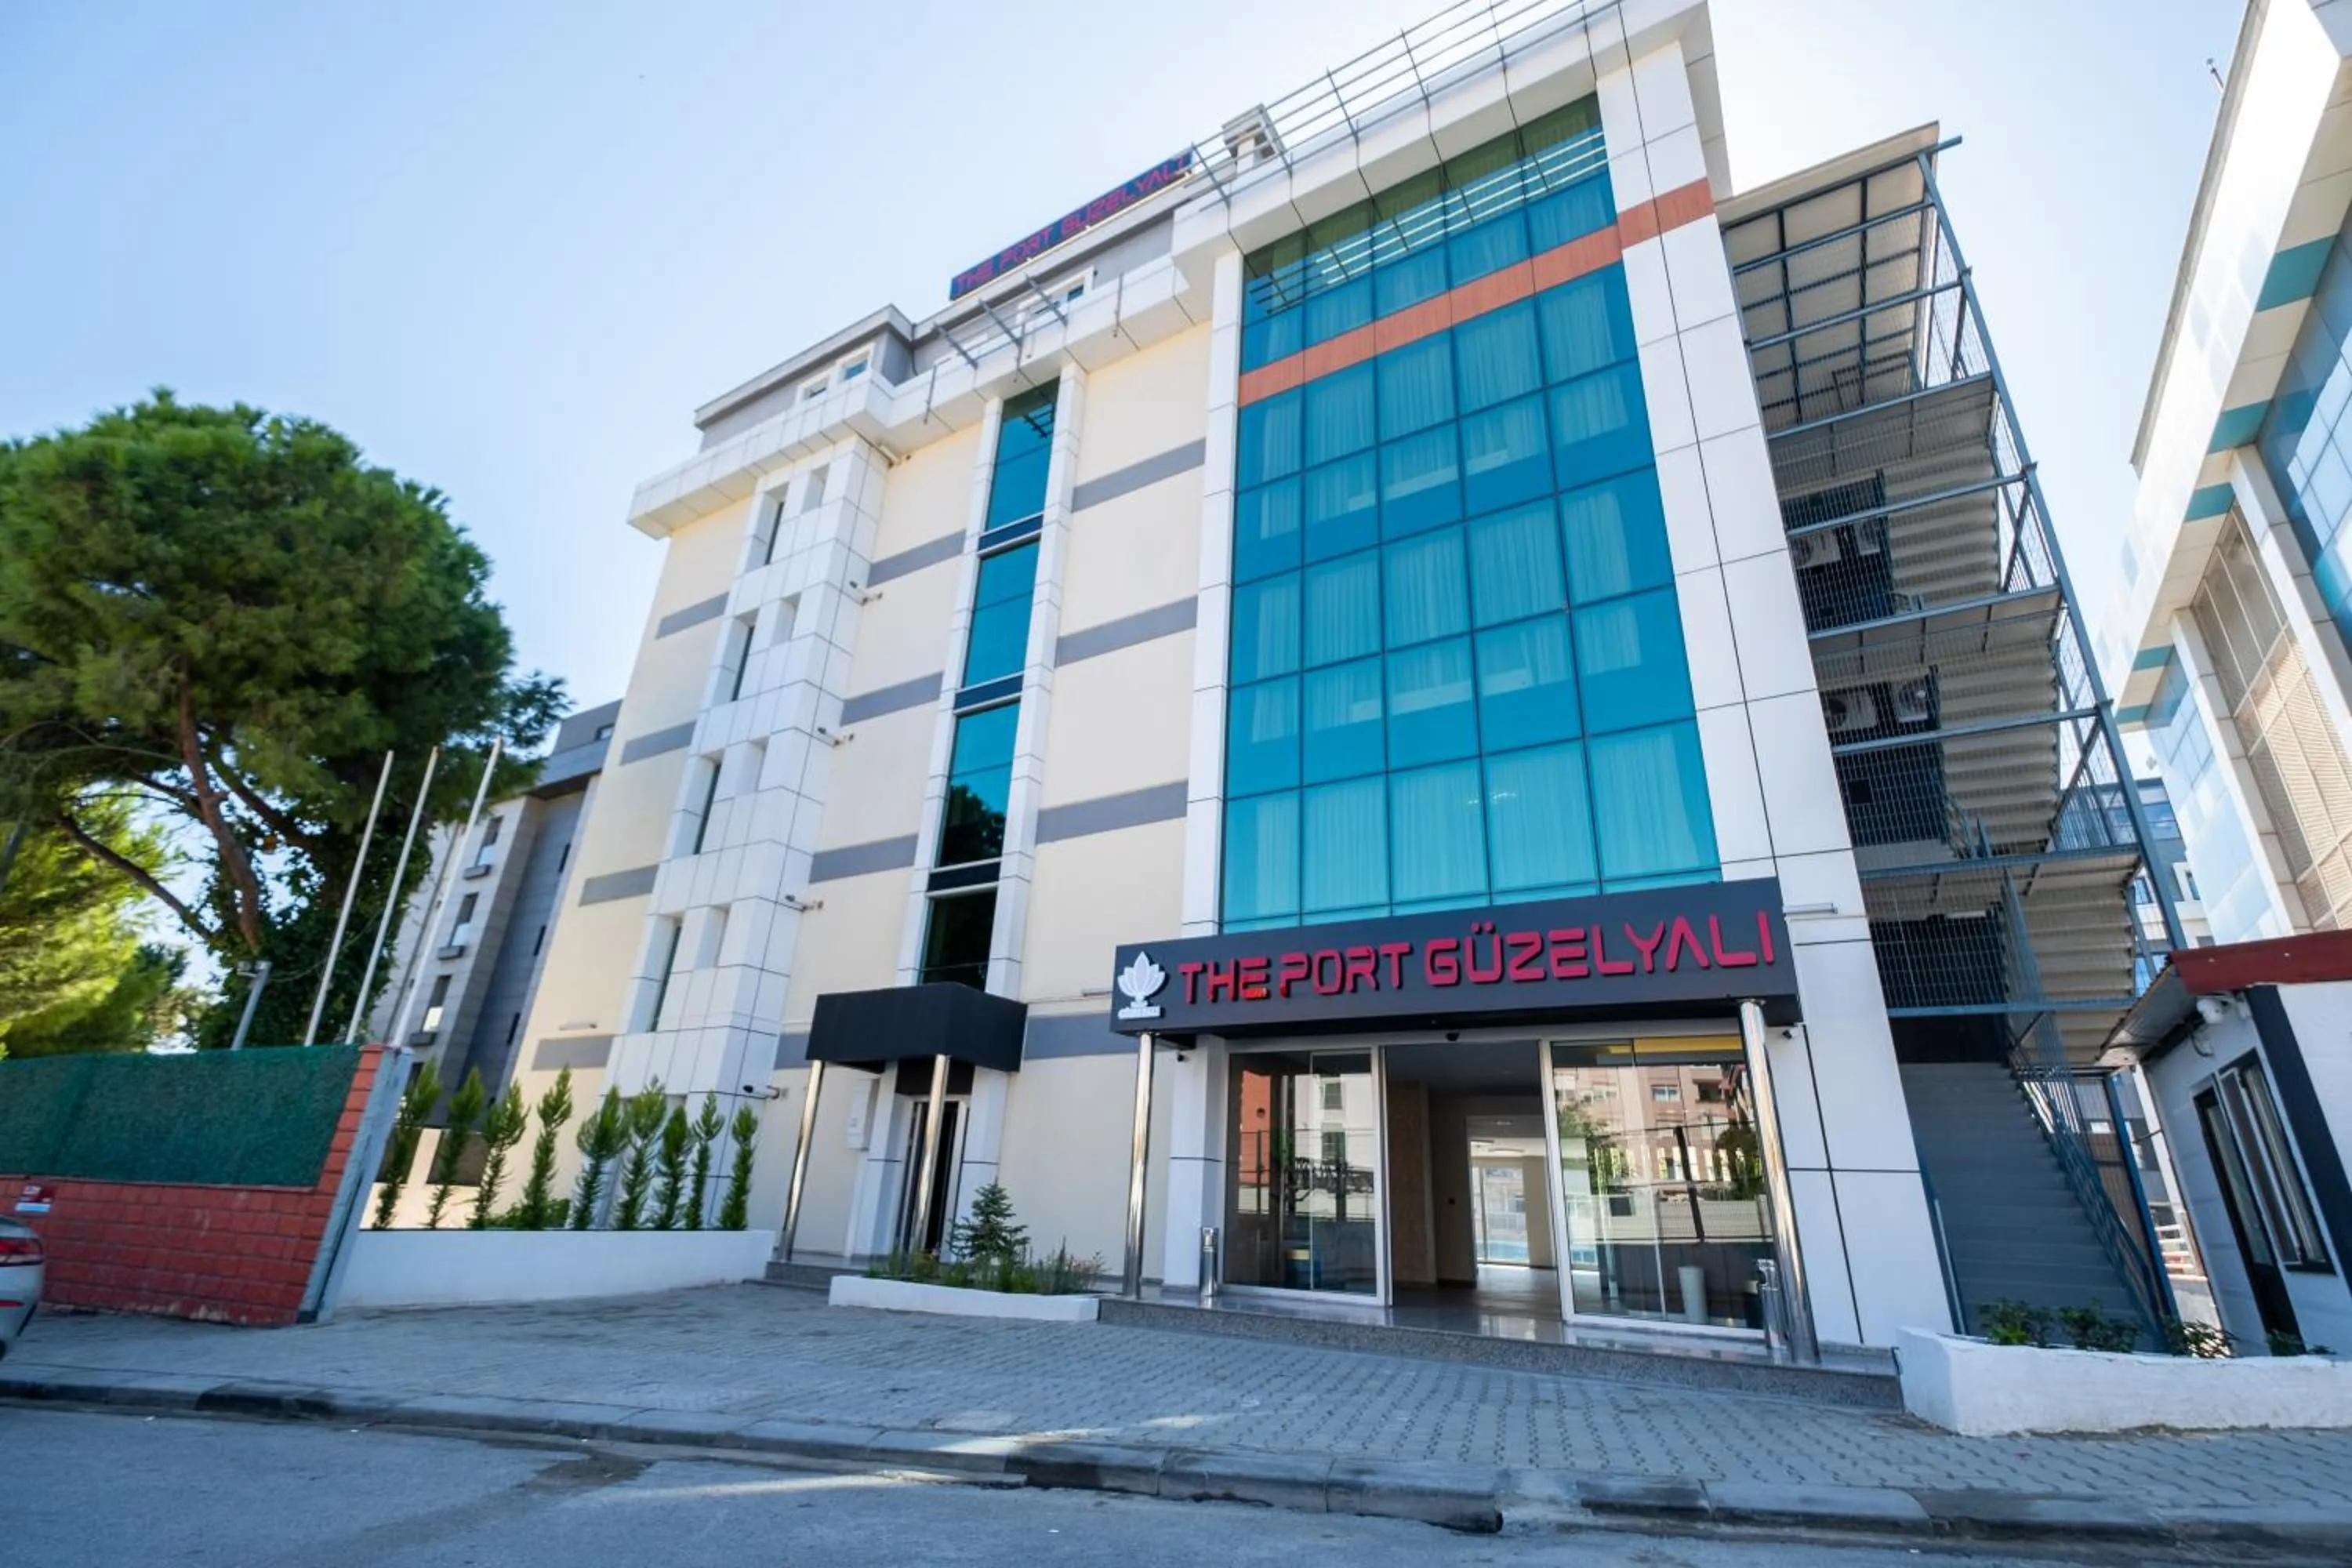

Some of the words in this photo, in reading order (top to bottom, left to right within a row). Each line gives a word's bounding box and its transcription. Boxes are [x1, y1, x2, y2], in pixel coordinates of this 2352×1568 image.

[957, 260, 993, 290] THE
[1000, 227, 1053, 270] PORT
[1178, 956, 1268, 1004] THE
[1280, 942, 1410, 996] PORT
[1424, 910, 1775, 985] GÜZELYALI
